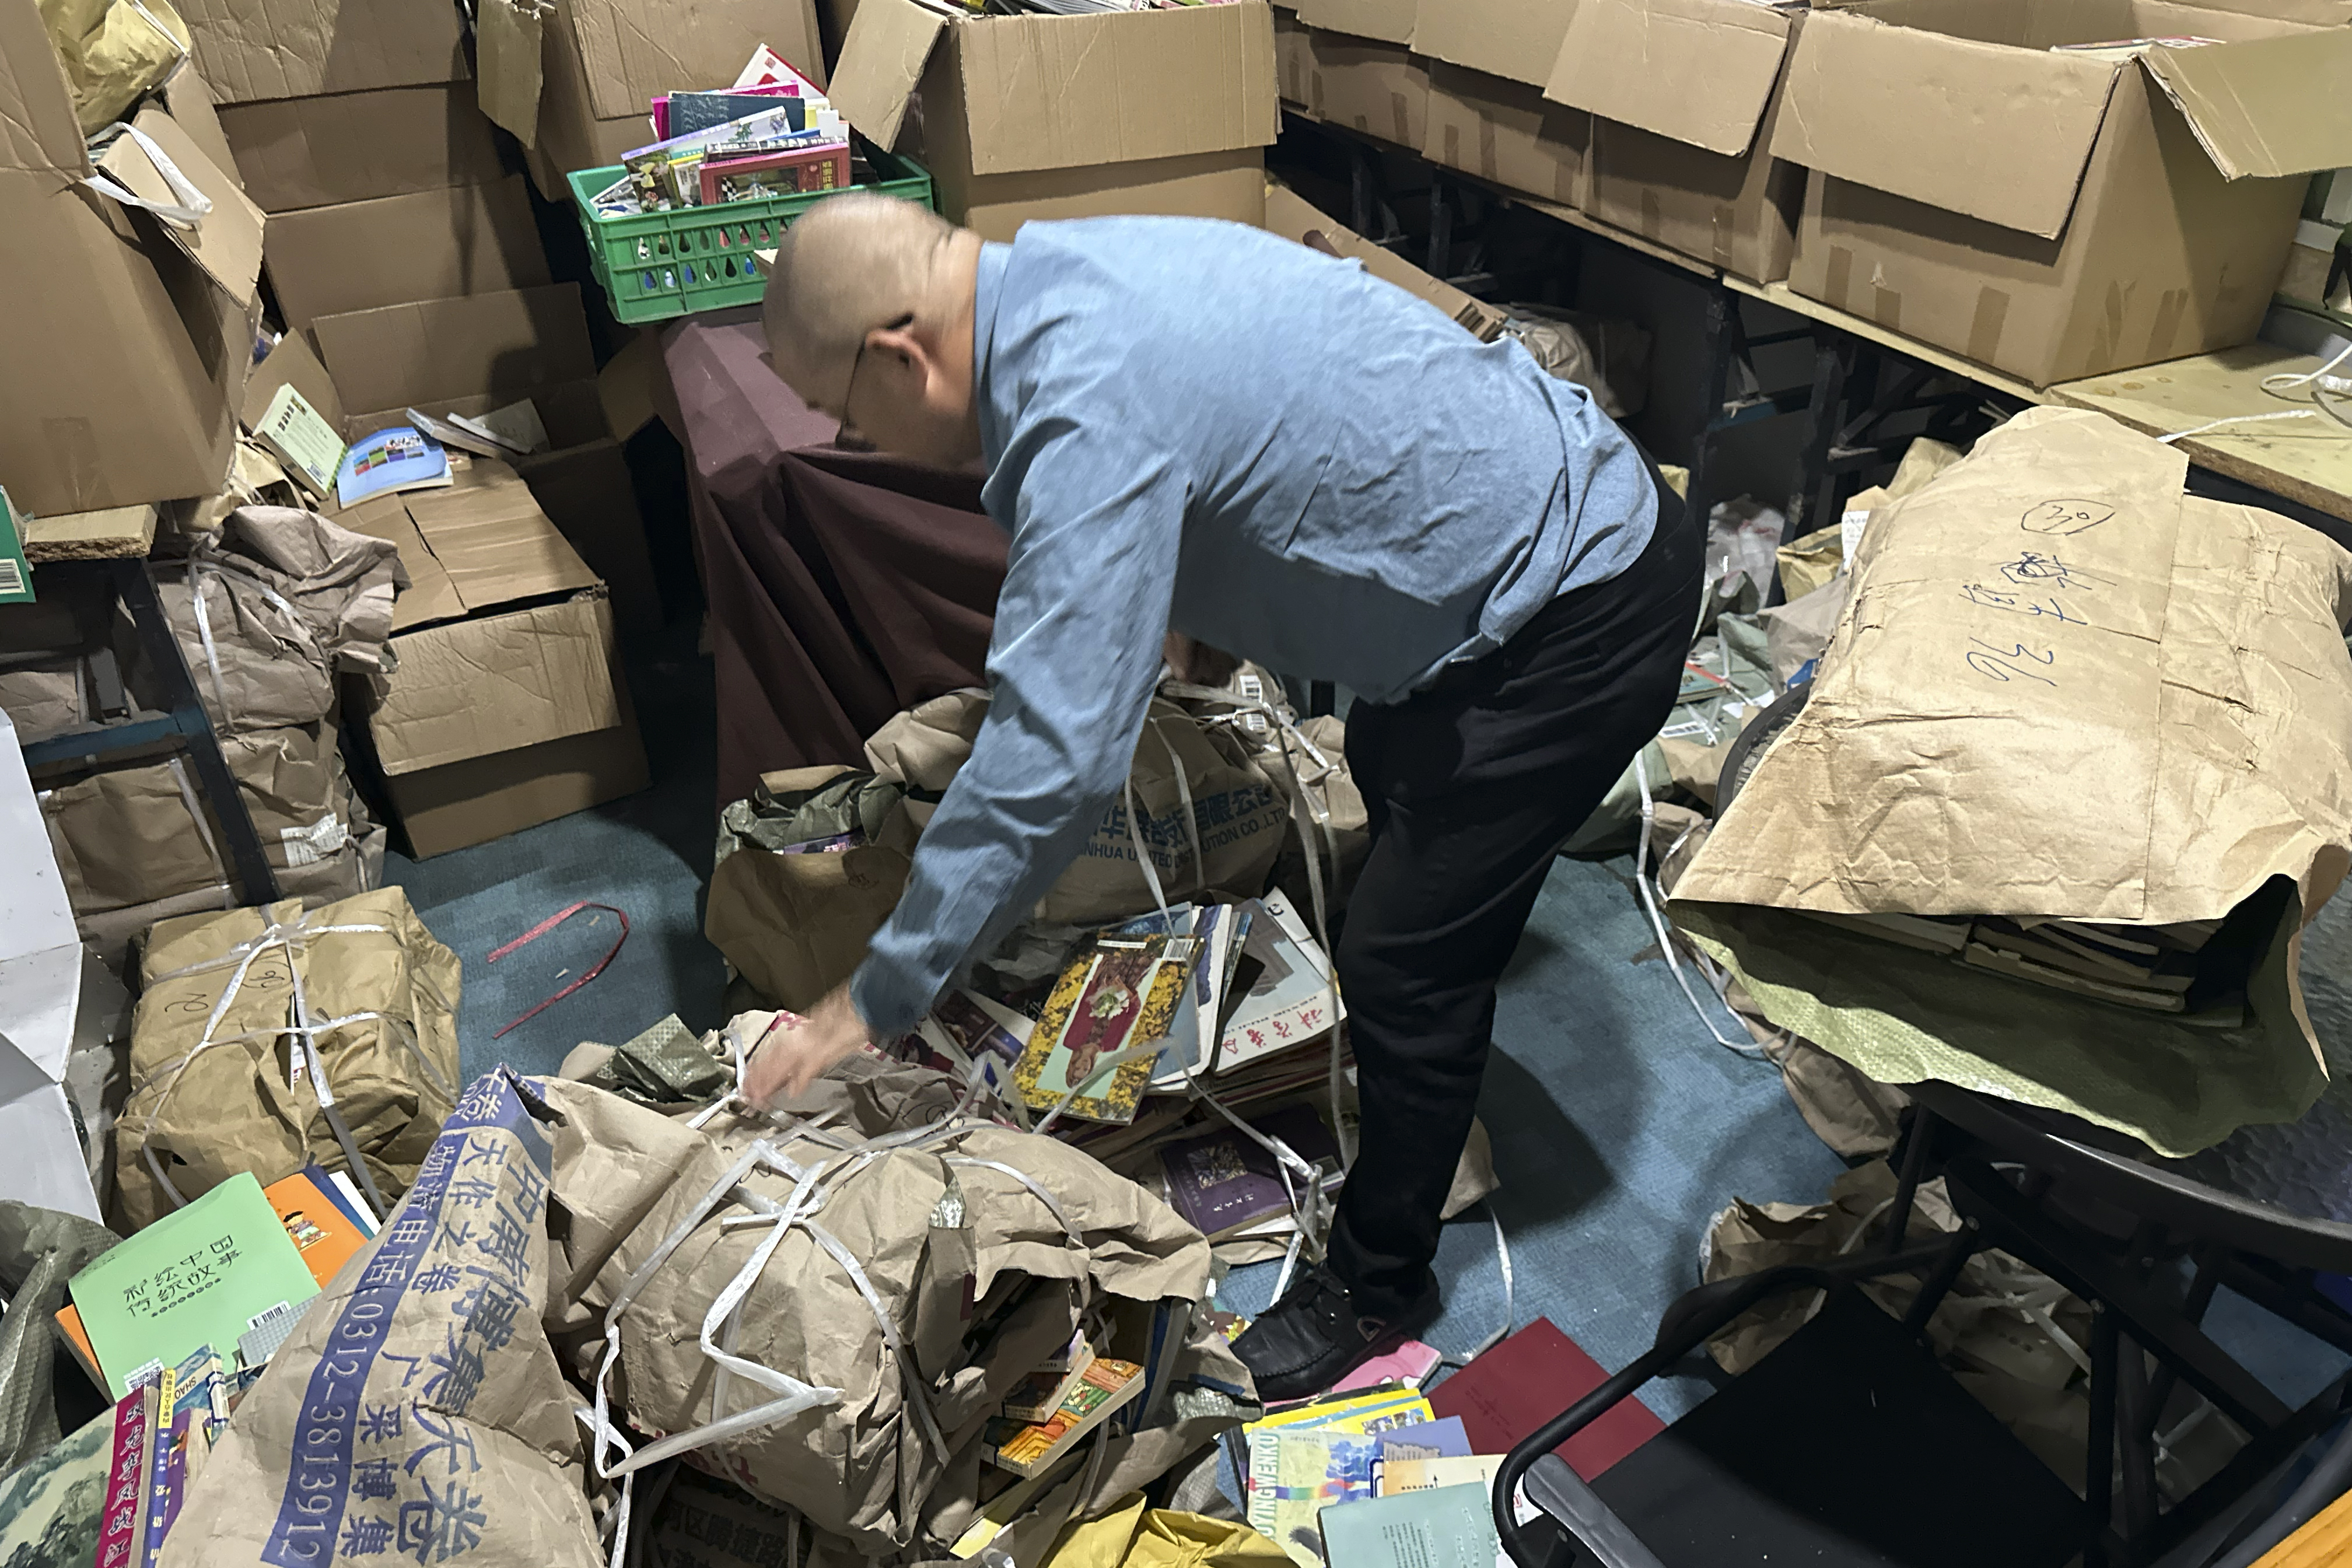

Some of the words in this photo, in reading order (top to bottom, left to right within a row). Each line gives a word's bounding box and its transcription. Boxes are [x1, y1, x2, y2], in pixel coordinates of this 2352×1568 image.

[1128, 847, 1172, 869] UITED
[1174, 825, 1240, 869] DISTUTION
[123, 1234, 233, 1303] 彩绘中国
[411, 1137, 509, 1295] 天作之卷
[126, 1250, 243, 1317] 传统故事
[398, 1160, 551, 1566] 中南博集天卷
[340, 1350, 422, 1559] 广采博集
[1254, 1432, 1280, 1540] UYINGWENKU
